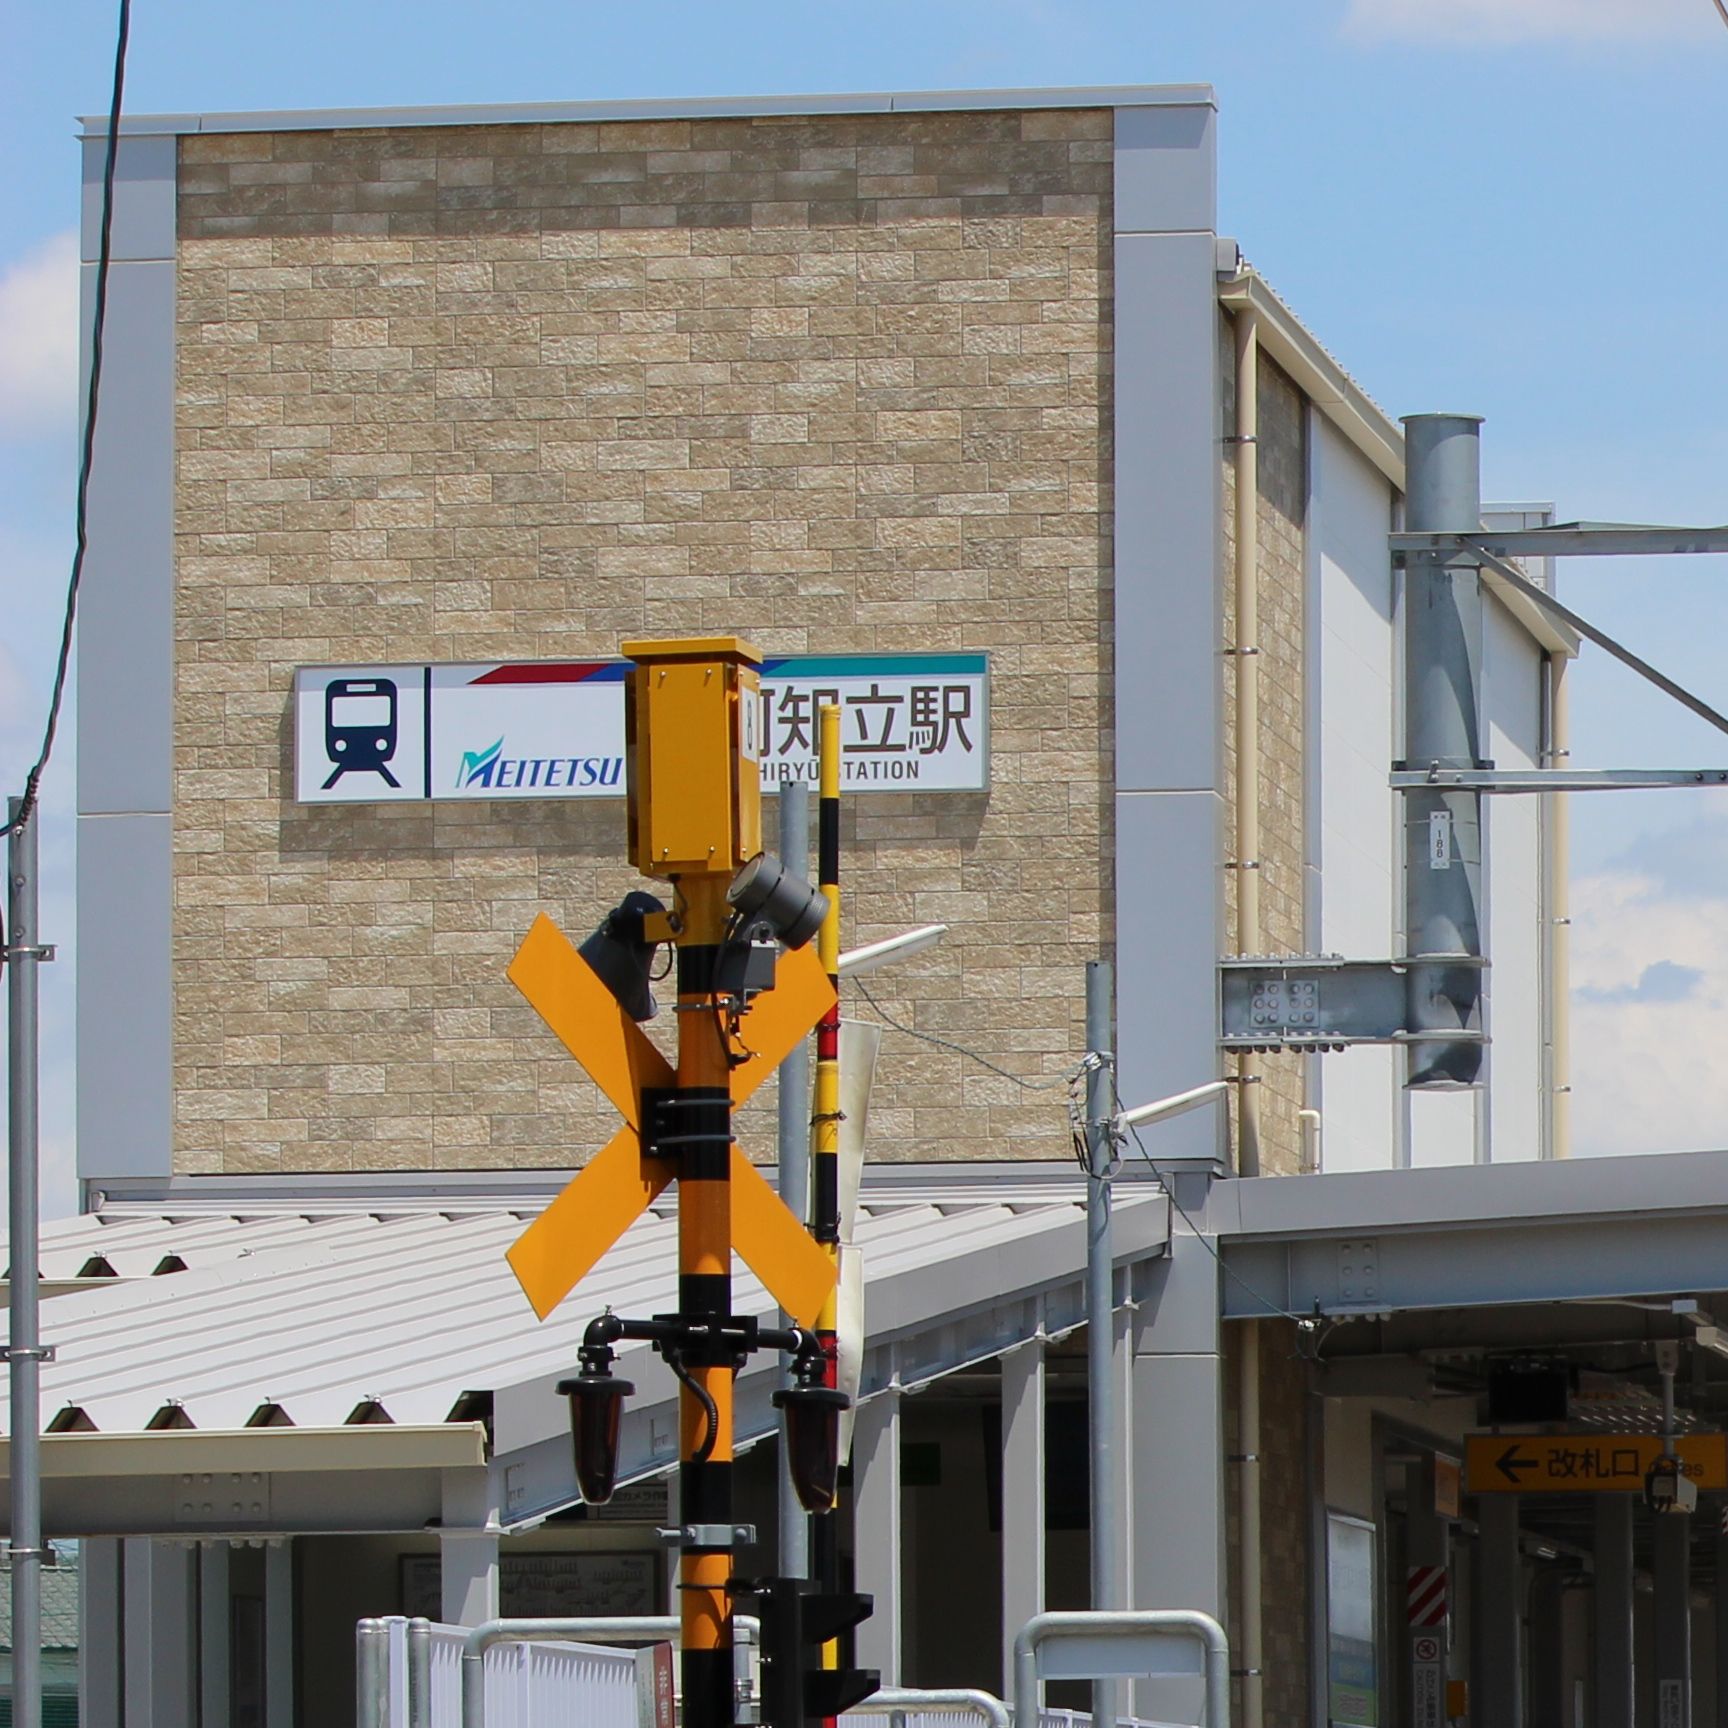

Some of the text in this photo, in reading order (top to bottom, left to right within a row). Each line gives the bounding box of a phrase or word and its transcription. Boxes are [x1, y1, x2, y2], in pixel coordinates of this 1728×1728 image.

[455, 734, 624, 788] MEITETSU
[838, 759, 919, 780] TATION
[1547, 1448, 1640, 1480] 改札口
